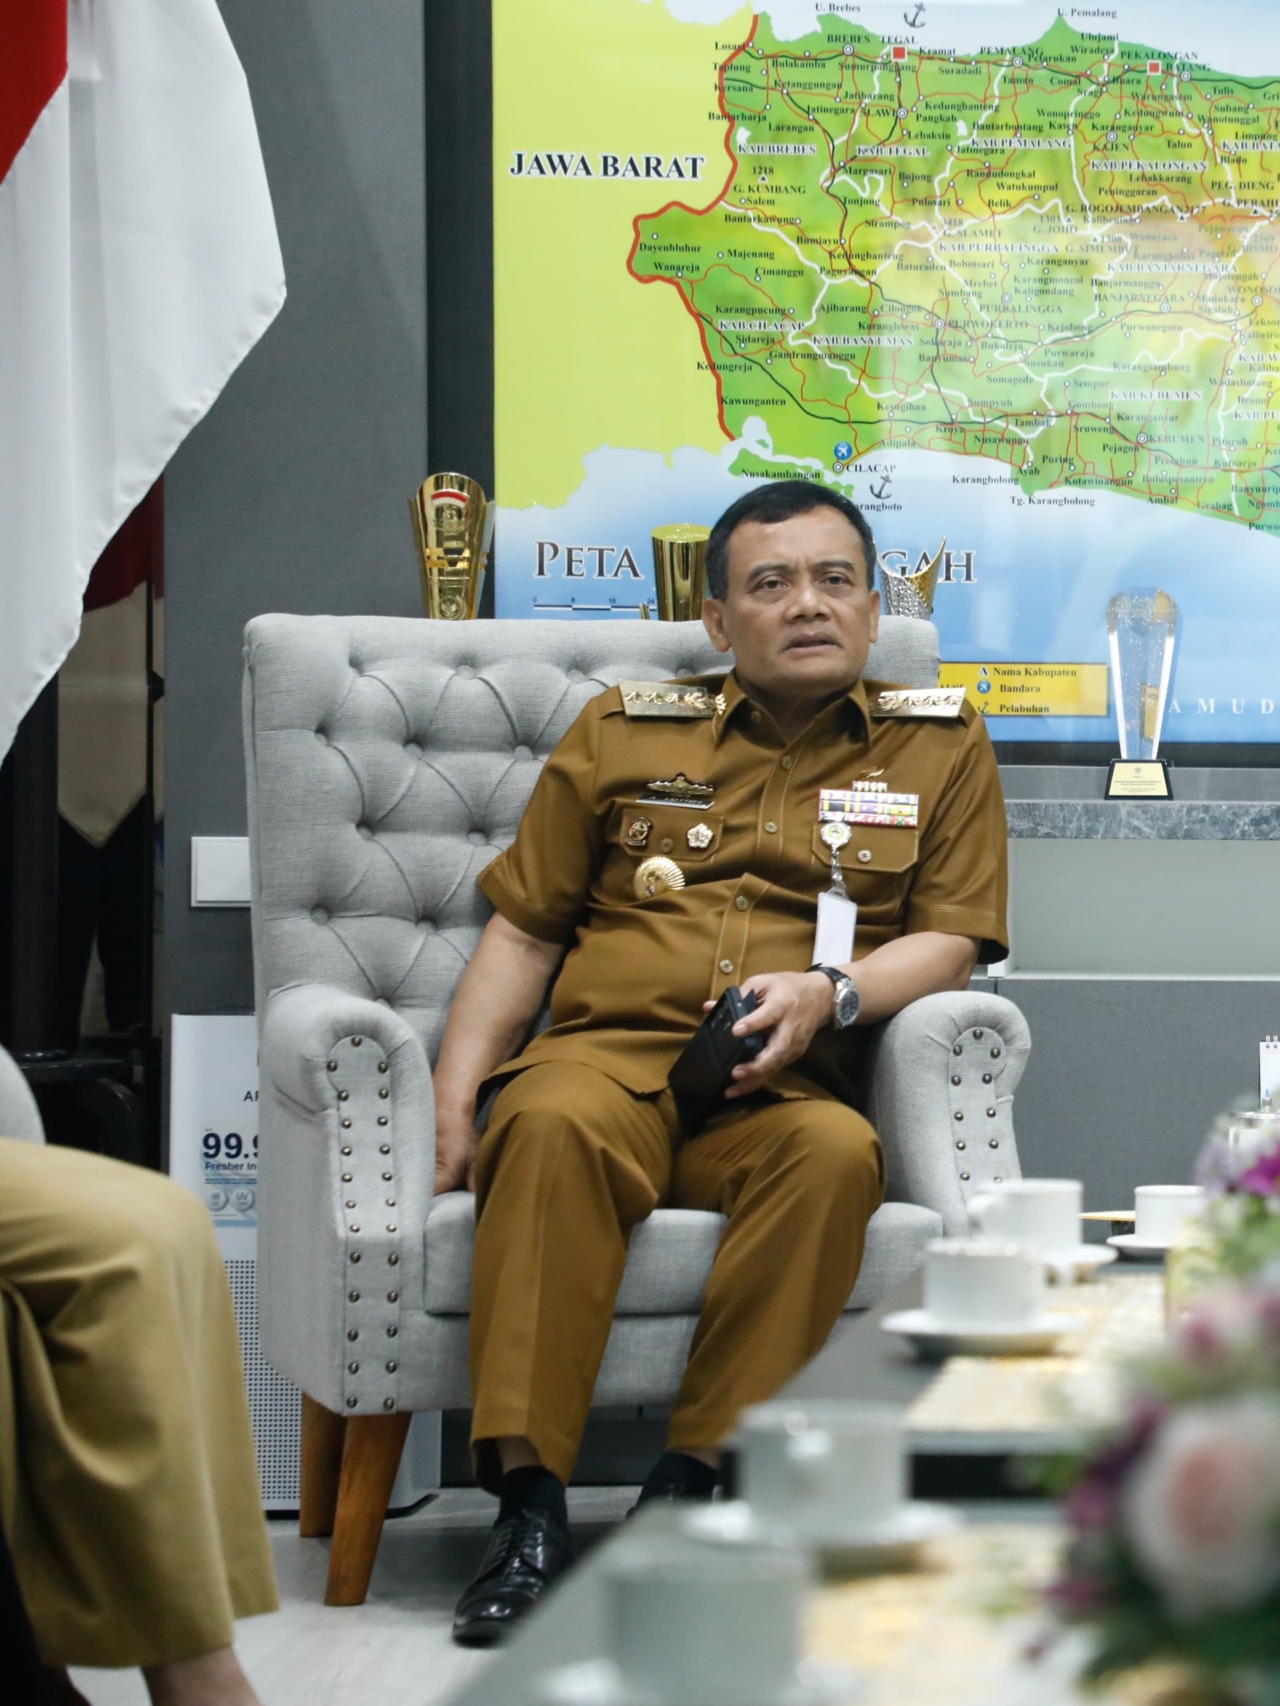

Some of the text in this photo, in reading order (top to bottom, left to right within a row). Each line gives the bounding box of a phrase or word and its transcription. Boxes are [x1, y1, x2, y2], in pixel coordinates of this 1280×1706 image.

[1058, 8, 1117, 18] U. Pemalang
[881, 36, 918, 44] TEGAL
[980, 47, 1043, 55] PEMALANG
[1071, 46, 1115, 54] Wiradesa
[1120, 51, 1198, 60] PEKALONGAN
[939, 67, 981, 75] Suradadi
[774, 80, 842, 89] Ketanggungan
[916, 114, 956, 122] Pangkah
[1037, 110, 1100, 119] Wonopringgo
[769, 124, 814, 132] Larangan
[972, 139, 1071, 148] KAB.PEMALANG
[1093, 143, 1129, 152] KAJEN
[1167, 141, 1192, 149] Talun
[858, 147, 930, 156] KAB.TEGAL
[511, 153, 704, 180] JAWA BARAT
[1092, 161, 1207, 170] KAB.PEKALONGAN
[899, 173, 932, 182] Bojong
[967, 170, 1035, 180] Randudongkal
[734, 185, 806, 194] G. KUMBANG
[1212, 182, 1234, 191] PEG.
[912, 199, 950, 207] Pulosari
[988, 200, 1011, 208] Belik
[797, 236, 839, 246] Bumiayu
[728, 251, 774, 260] Majenang
[1027, 258, 1089, 267] Karanganyar
[654, 263, 699, 273] Wanareja
[756, 267, 804, 277] Cimanggu
[716, 305, 786, 315] Karangpucung
[820, 304, 866, 314] Ajibarang
[949, 320, 1029, 329] PURWOKERTO
[1048, 323, 1092, 332] Kejobong
[736, 336, 775, 344] Sidareja
[812, 336, 913, 346] KAB.BANYUMAS
[769, 351, 856, 360] Gandrungmanggu
[697, 362, 752, 372] Kedungreja
[721, 397, 786, 406] Kawunganten
[1042, 456, 1074, 464] Puring
[846, 464, 896, 473] CILACAP
[741, 470, 820, 479] Nusakambangan
[952, 476, 1018, 485] Karangbolong
[1010, 497, 1095, 506] Tg. Karangbolong
[534, 541, 643, 579] PETA
[979, 667, 989, 676] A
[993, 668, 1076, 677] Nama Kabupaten
[1000, 704, 1049, 713] Pelabuhan
[205, 1162, 243, 1171] Fresher
